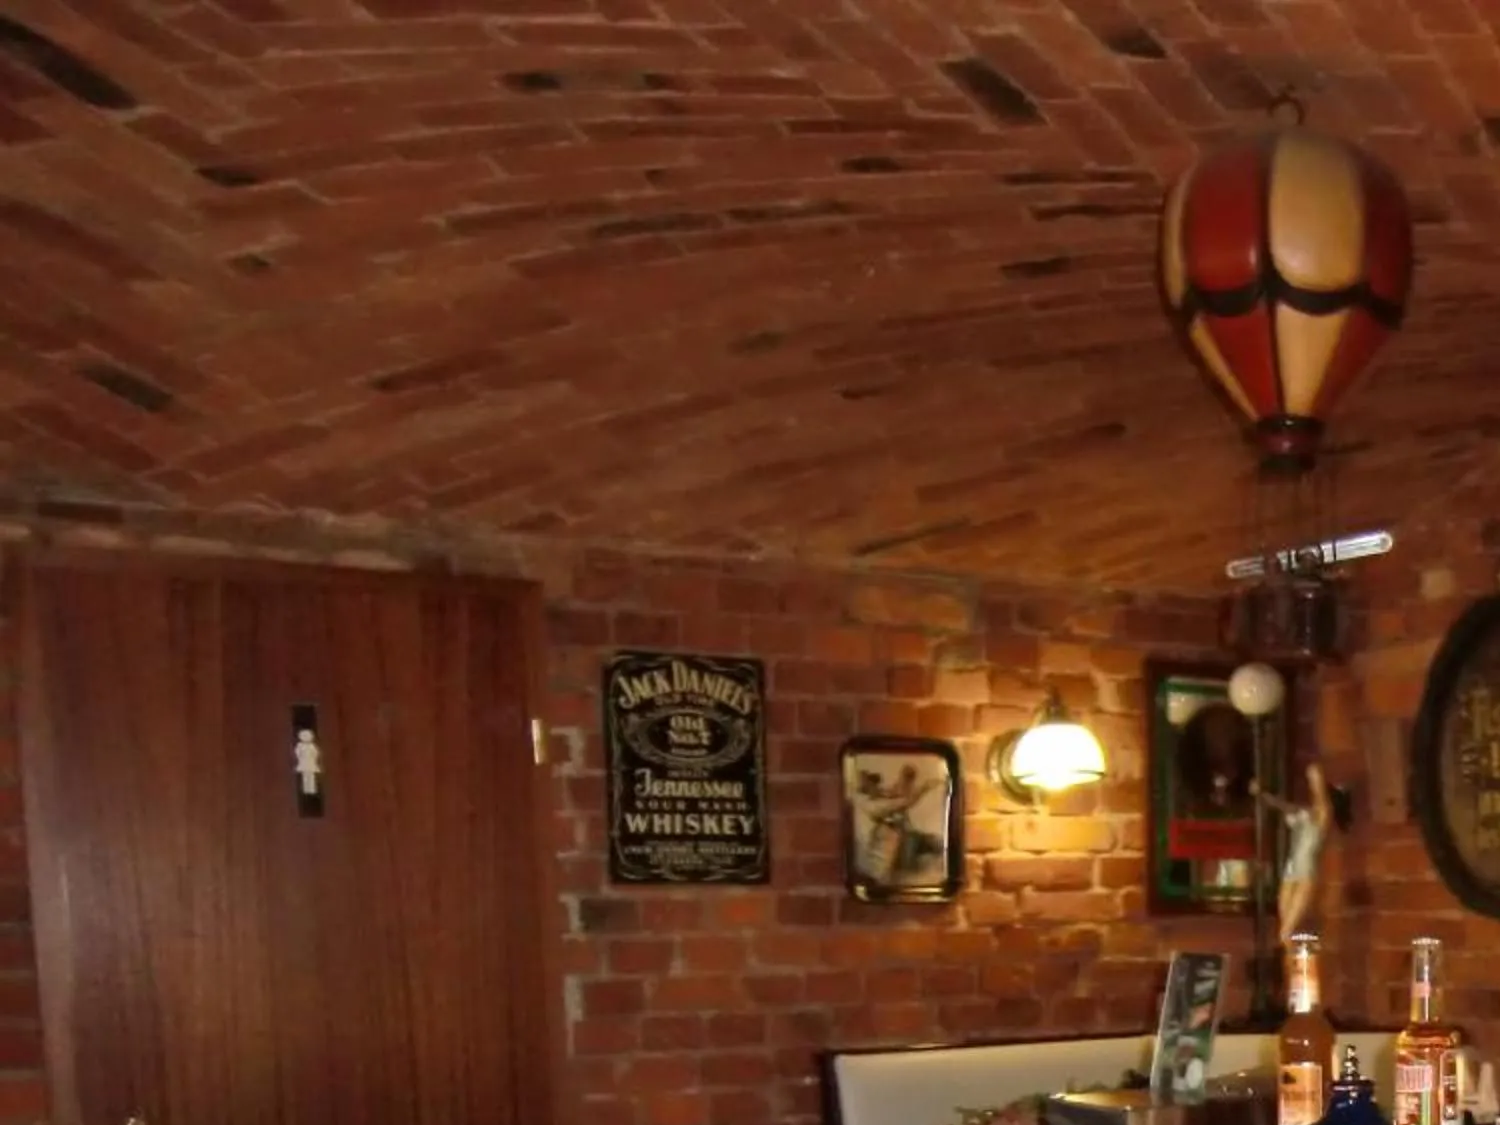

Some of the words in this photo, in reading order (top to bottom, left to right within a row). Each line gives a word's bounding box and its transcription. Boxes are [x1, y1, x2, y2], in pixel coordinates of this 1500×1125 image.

[618, 670, 672, 709] JACK
[634, 768, 745, 799] Tennessee
[625, 814, 756, 837] WHISKEY
